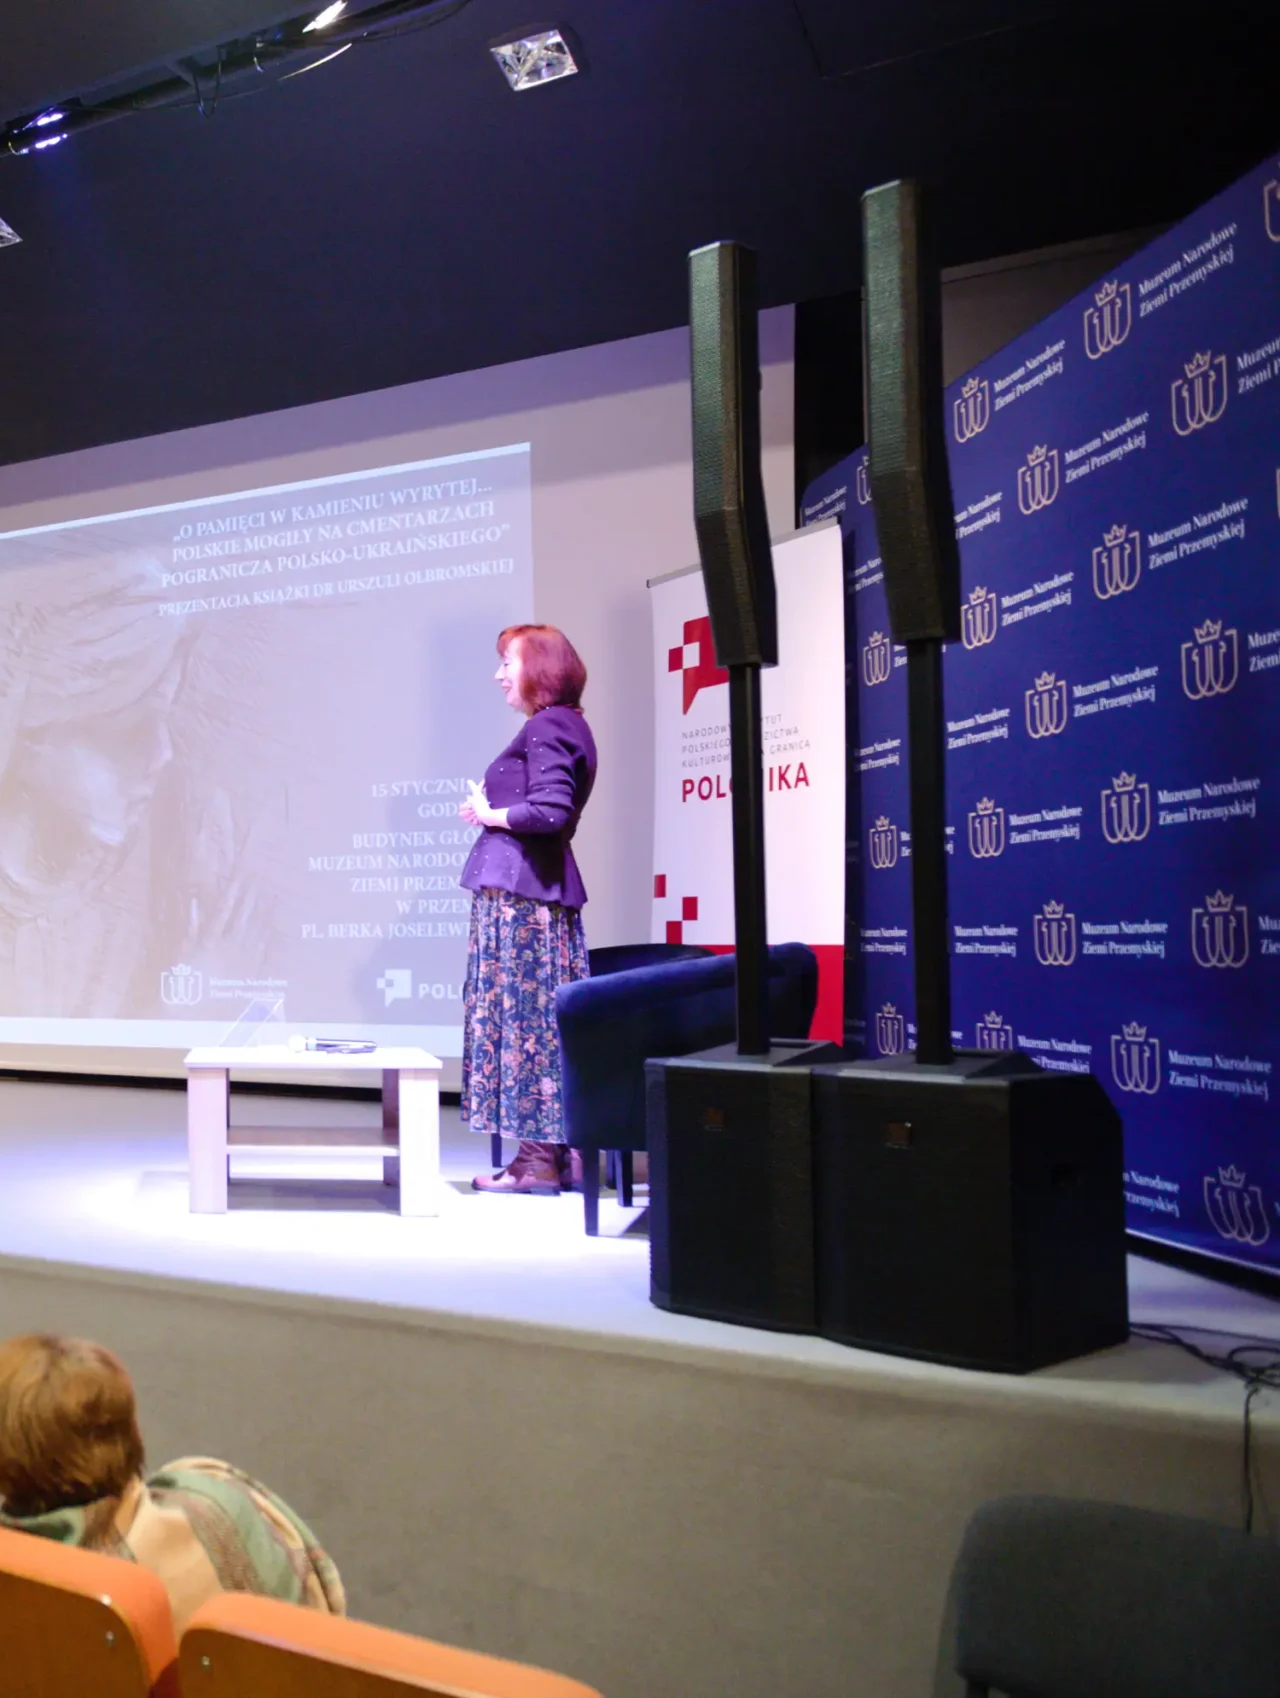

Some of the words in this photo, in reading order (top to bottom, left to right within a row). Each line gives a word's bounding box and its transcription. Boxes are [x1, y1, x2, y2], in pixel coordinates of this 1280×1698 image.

[1139, 260, 1181, 297] Muzeum
[1182, 222, 1237, 267] Narodowe
[197, 511, 266, 538] PAMIĘCI
[270, 508, 287, 524] W
[291, 493, 384, 522] KAMIENIU
[1148, 522, 1192, 548] Muzeum
[1192, 498, 1249, 531] Narodowe
[172, 539, 241, 564] POLSKIE
[244, 527, 313, 553] MOGIŁY
[318, 524, 343, 540] NA
[346, 500, 495, 537] CMENTARZACH
[1148, 545, 1178, 570] Ziemi
[1179, 519, 1245, 558] Przemyskiej
[162, 559, 272, 588] POGRANICZA
[158, 594, 250, 617] PREZENTACJA
[313, 581, 333, 597] DR
[337, 573, 400, 594] URSZULI
[1248, 628, 1280, 650] Muze
[1072, 678, 1110, 698] Muzeum
[1110, 665, 1159, 688] Narodowe
[1074, 699, 1099, 717] Ziemi
[1099, 684, 1156, 710] Przemyskiej
[682, 754, 731, 768] KULTUROW
[682, 762, 810, 803] POLIKA
[1157, 786, 1202, 804] Muzeum
[1203, 776, 1261, 799] Narodowe
[417, 801, 459, 818] GOD
[1008, 808, 1041, 826] Muzeum
[1041, 804, 1083, 821] Narodowe
[1158, 809, 1188, 826] Ziemi
[1189, 798, 1256, 823] Przemyskiej
[352, 830, 435, 849] BUDYNEK
[308, 853, 383, 872] MUZEUM
[387, 850, 470, 869] NARODO
[351, 876, 399, 893] ZIEMI
[403, 875, 461, 892] PRZEM
[396, 900, 413, 914] W
[327, 922, 383, 938] BERKA
[1081, 922, 1120, 936] Muzeum
[1120, 919, 1168, 935] Narodowe
[1082, 940, 1108, 955] Ziemi
[1108, 939, 1165, 959] Przemyskiej
[1017, 1034, 1051, 1051] Muzeum
[1050, 1037, 1092, 1055] Narodowe
[1168, 1049, 1213, 1069] Muzeum
[1214, 1053, 1272, 1075] Narodowe
[1169, 1069, 1199, 1089] Ziemi
[1200, 1074, 1269, 1103] Przemyskiej
[1123, 1190, 1180, 1219] rzemyskiej
